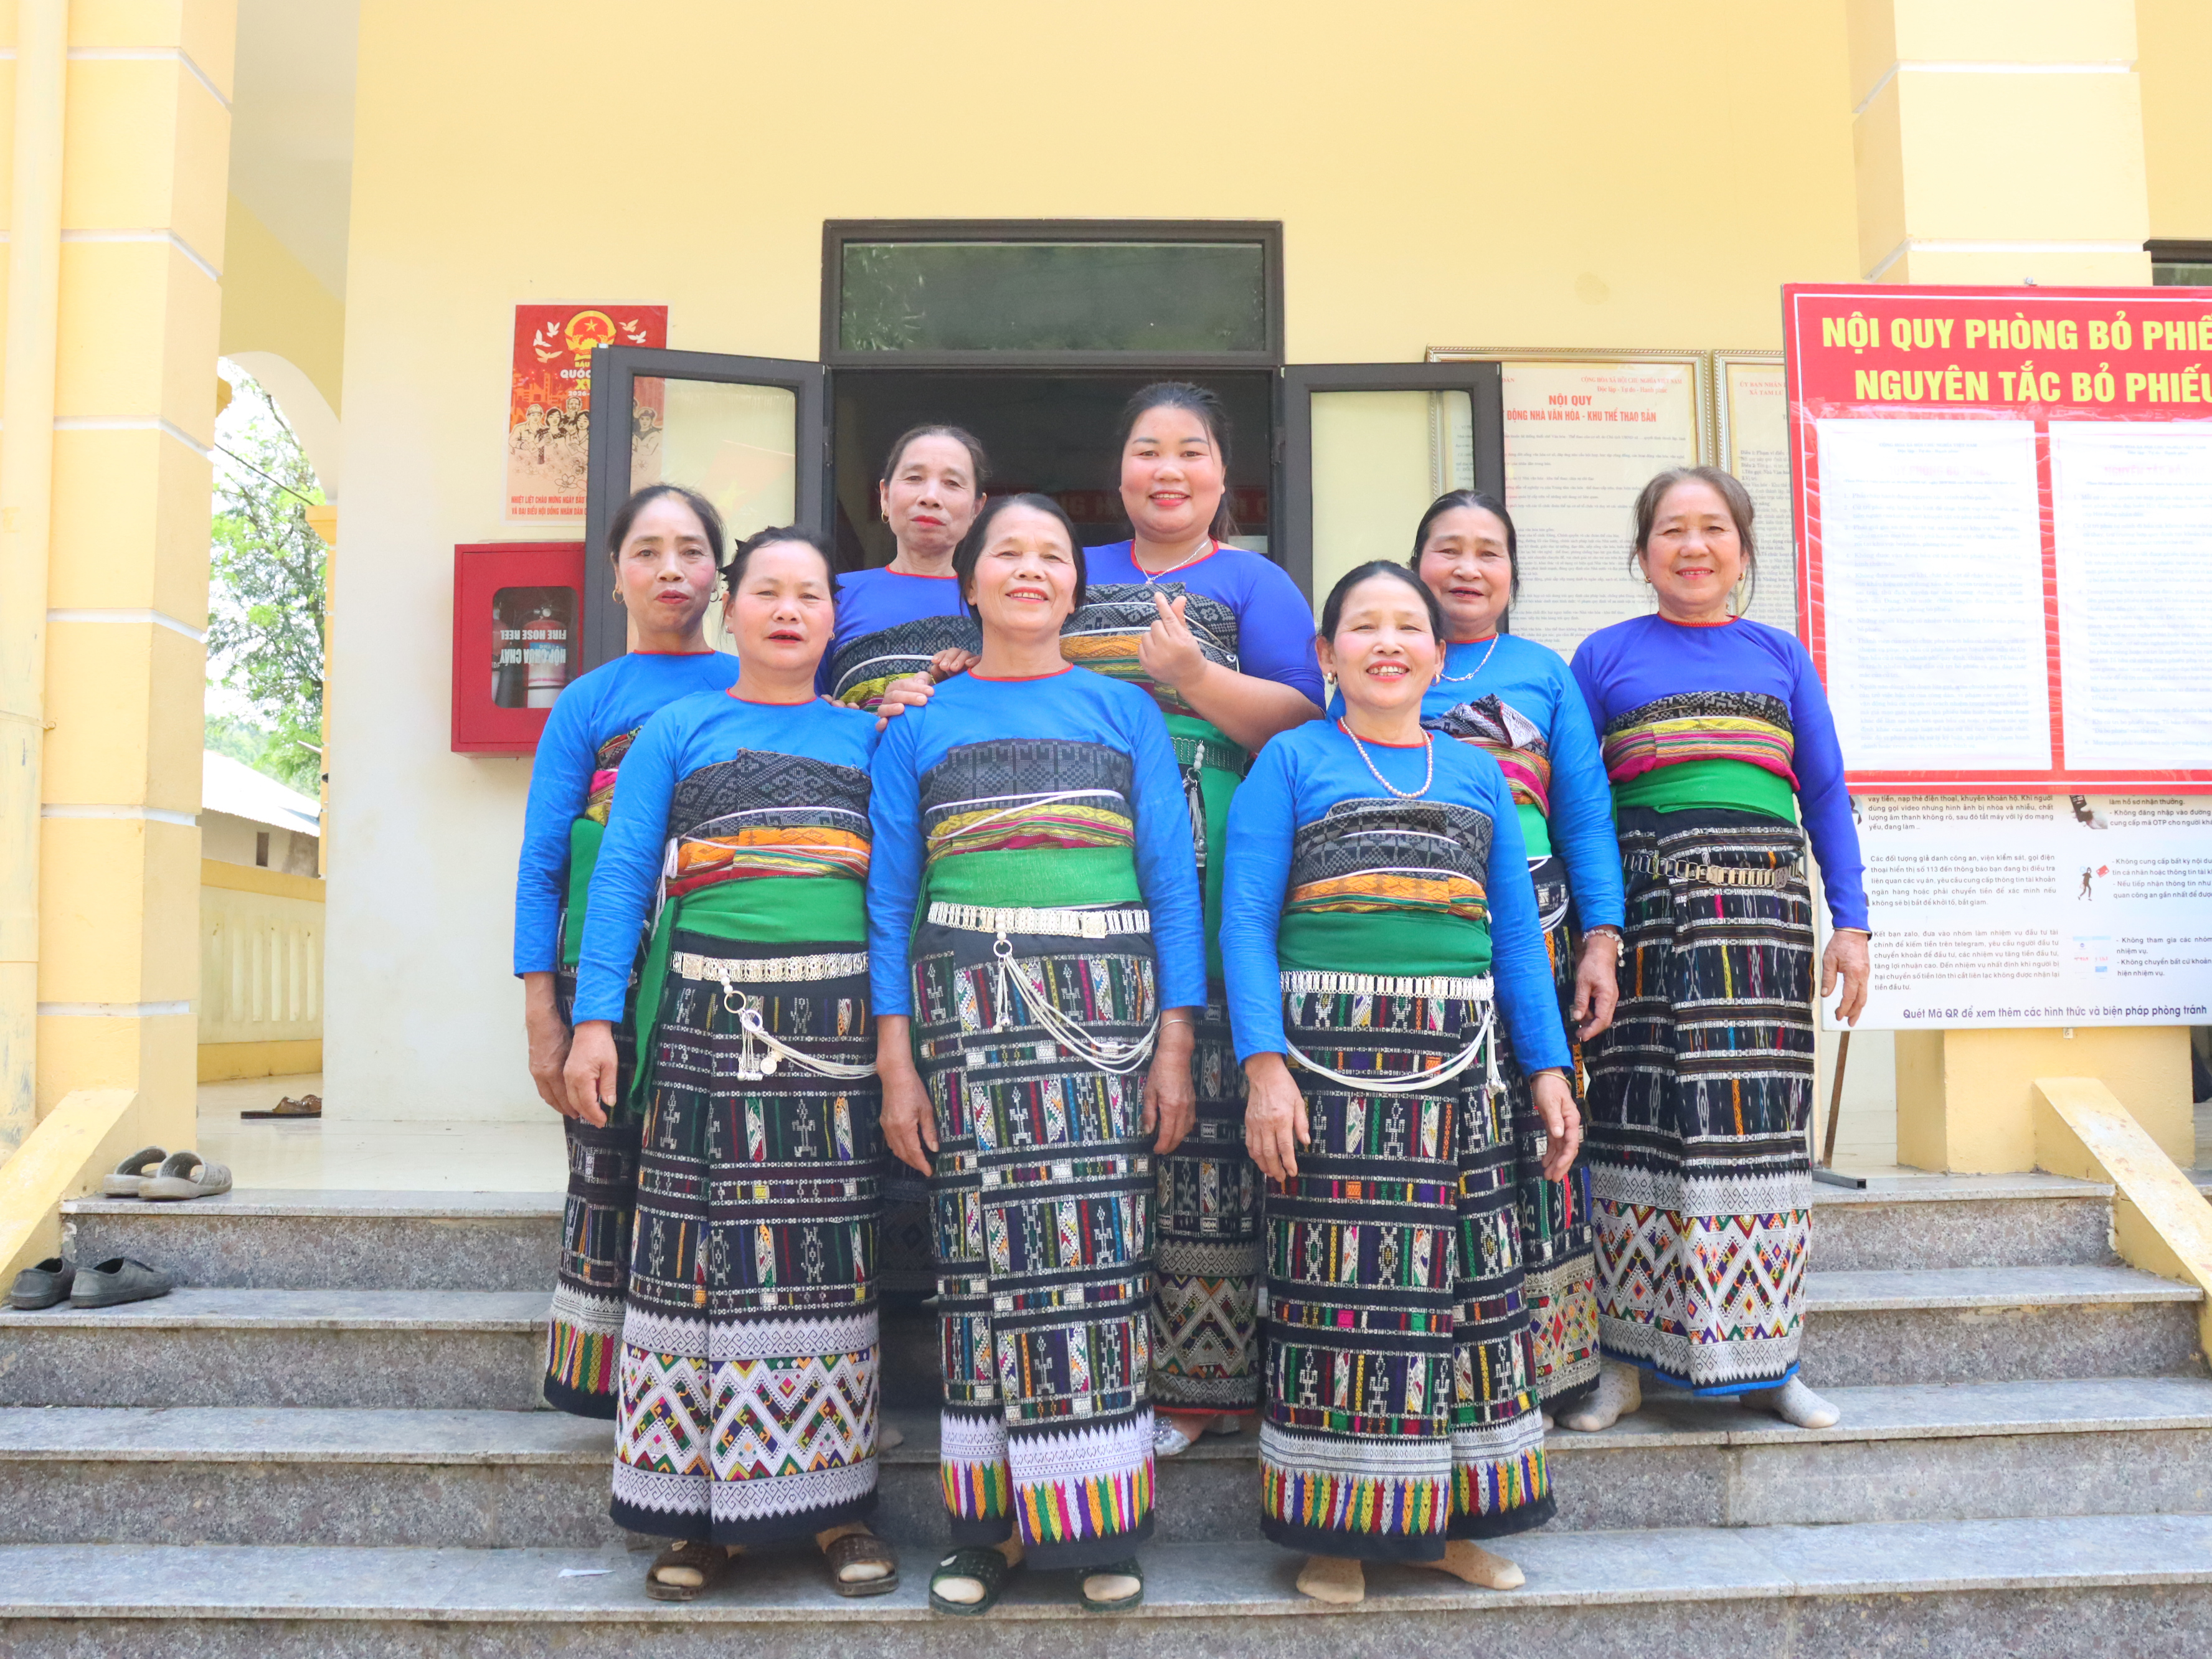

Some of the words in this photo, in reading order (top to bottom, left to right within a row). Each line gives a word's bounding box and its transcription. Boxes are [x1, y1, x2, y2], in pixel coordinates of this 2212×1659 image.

[1822, 311, 1879, 354] NỘI
[1891, 318, 1954, 351] QUY
[1965, 313, 2078, 350] PHÒNG
[2089, 311, 2132, 350] BỎ
[560, 367, 591, 379] QUỐC
[1855, 365, 1988, 400] NGUYÊN
[1998, 361, 2061, 402] TẮC
[2071, 362, 2115, 402] BỎ
[1549, 393, 1567, 407] NỘI
[1571, 395, 1592, 406] QUY
[1506, 408, 1528, 422] ĐỘNG
[1529, 408, 1546, 420] NHÀ
[1547, 408, 1562, 420] VĂN
[1564, 409, 1580, 420] HÓA
[1587, 410, 1602, 421] KHU
[1604, 407, 1618, 421] THỂ
[1620, 411, 1638, 422] THAO
[1640, 409, 1656, 422] BẢN
[511, 495, 524, 505] NHIỆT
[526, 495, 534, 505] LIỆT
[536, 495, 547, 503] CHÀO
[563, 494, 574, 503] NGÀY
[512, 506, 518, 514] VÀ
[501, 630, 520, 640] REEL
[522, 630, 546, 640] HOSE
[547, 630, 567, 640] FIRE
[1885, 854, 1896, 863] đối
[1897, 854, 1917, 863] tượng
[1950, 854, 1966, 863] công
[2132, 879, 2145, 887] tiếp
[2121, 958, 2143, 967] Không
[2144, 957, 2168, 966] chuyển
[1903, 1008, 1925, 1018] Quét
[1928, 1008, 1942, 1018] Mã
[1945, 1008, 1958, 1018] QR
[1961, 1006, 1973, 1018] để
[1998, 1007, 2021, 1017] thêm
[2024, 1006, 2041, 1016] các
[2044, 1006, 2063, 1016] hình
[2066, 1006, 2085, 1016] thức
[2089, 1006, 2099, 1015] và
[2103, 1005, 2122, 1018] biện
[2125, 1005, 2148, 1017] pháp
[2152, 1004, 2180, 1018] phòng
[2183, 1004, 2206, 1014] tránh
